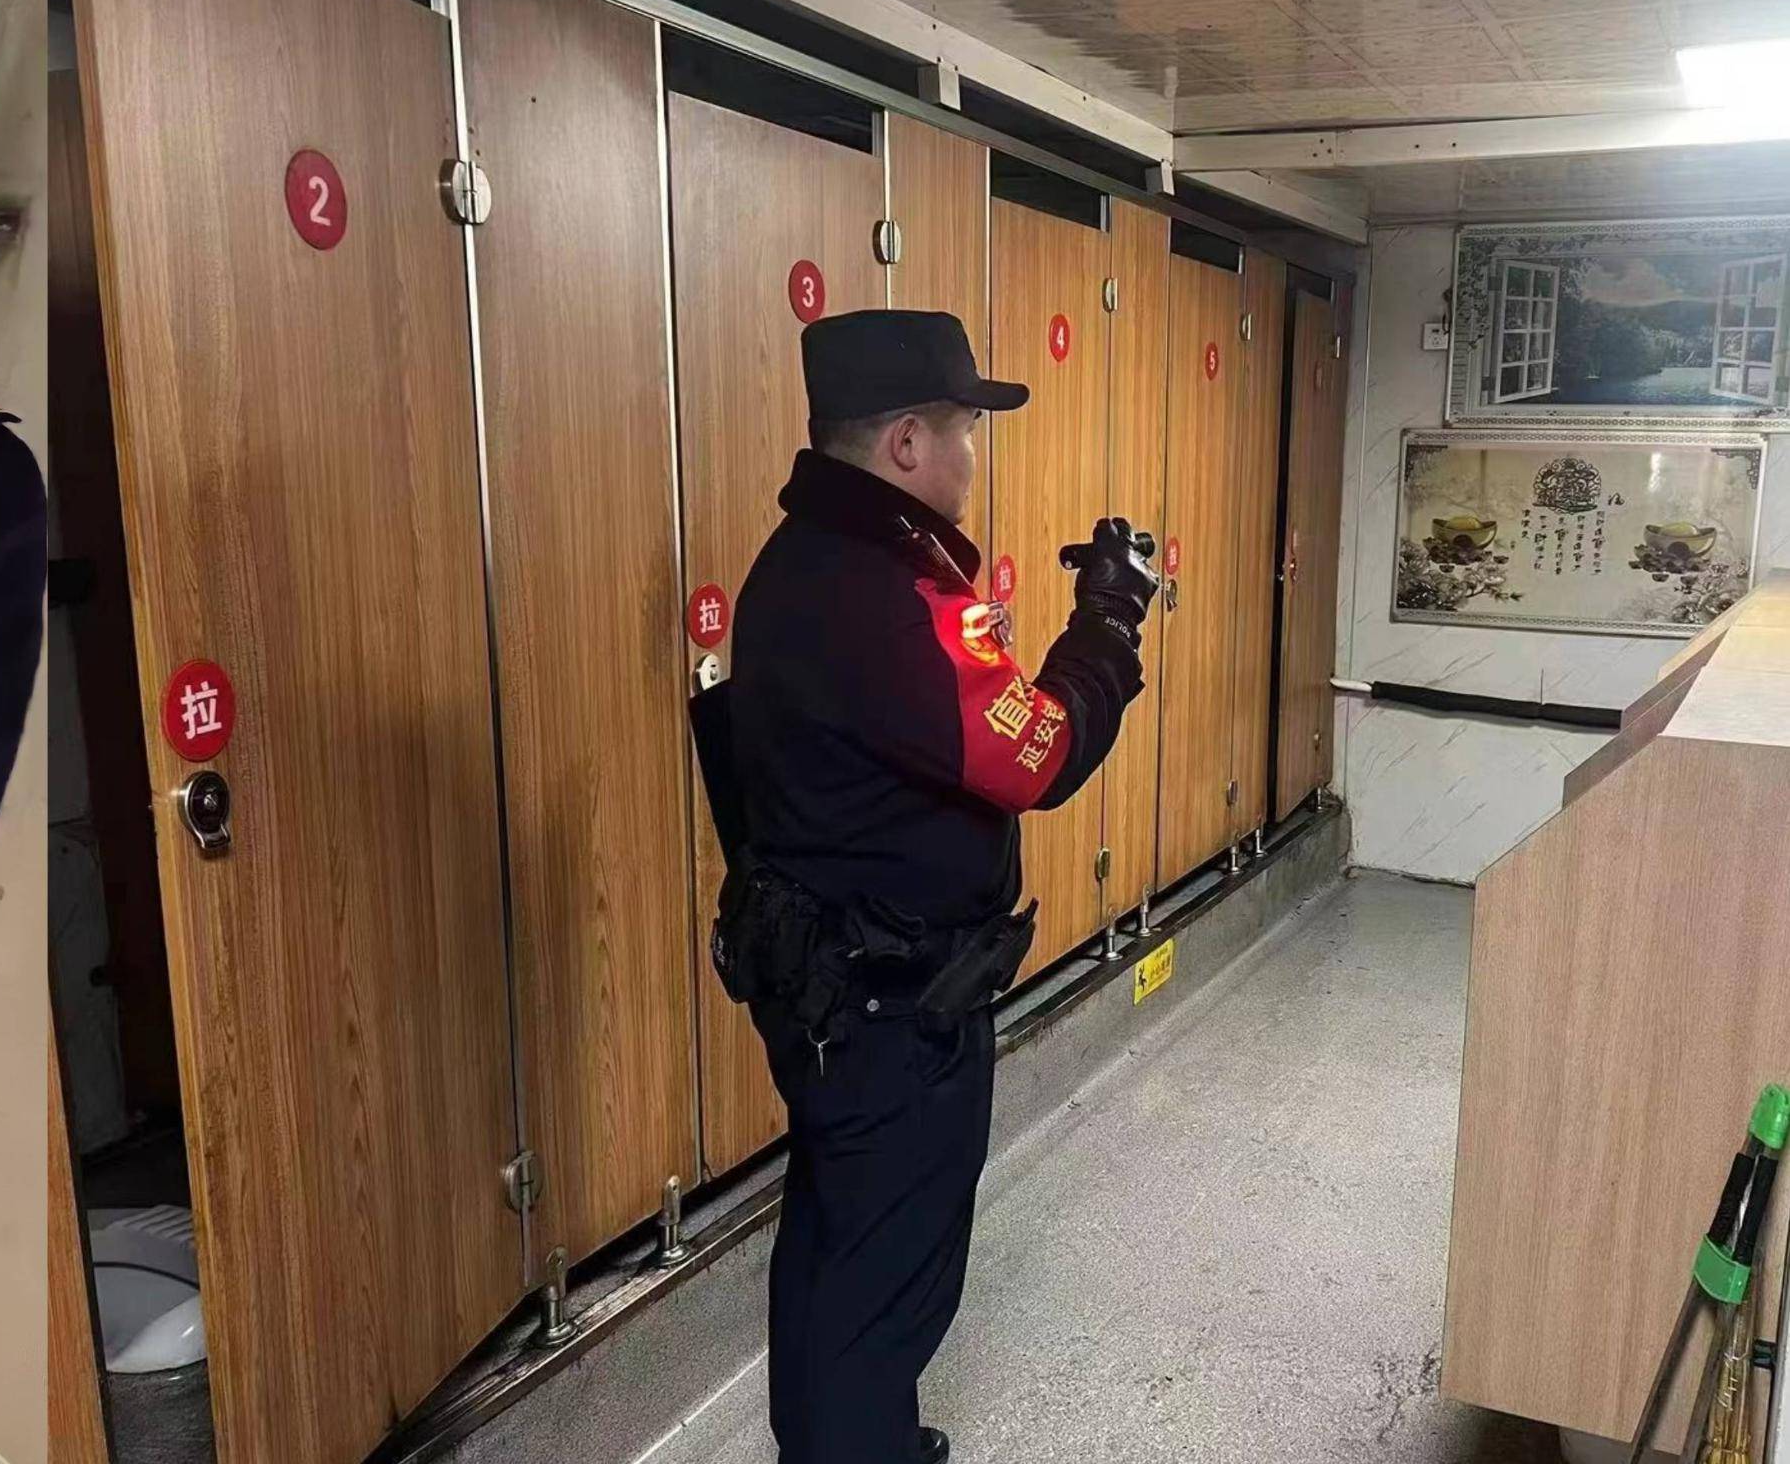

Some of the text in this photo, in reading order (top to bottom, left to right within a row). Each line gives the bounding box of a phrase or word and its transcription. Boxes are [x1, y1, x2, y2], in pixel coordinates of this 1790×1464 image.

[308, 176, 331, 227] 2
[802, 276, 815, 308] 3
[1056, 326, 1065, 349] 4
[1209, 351, 1216, 371] 5
[998, 564, 1011, 592] 拉
[699, 597, 723, 634] 拉
[1104, 616, 1131, 639] POLICE
[180, 681, 222, 740] 拉
